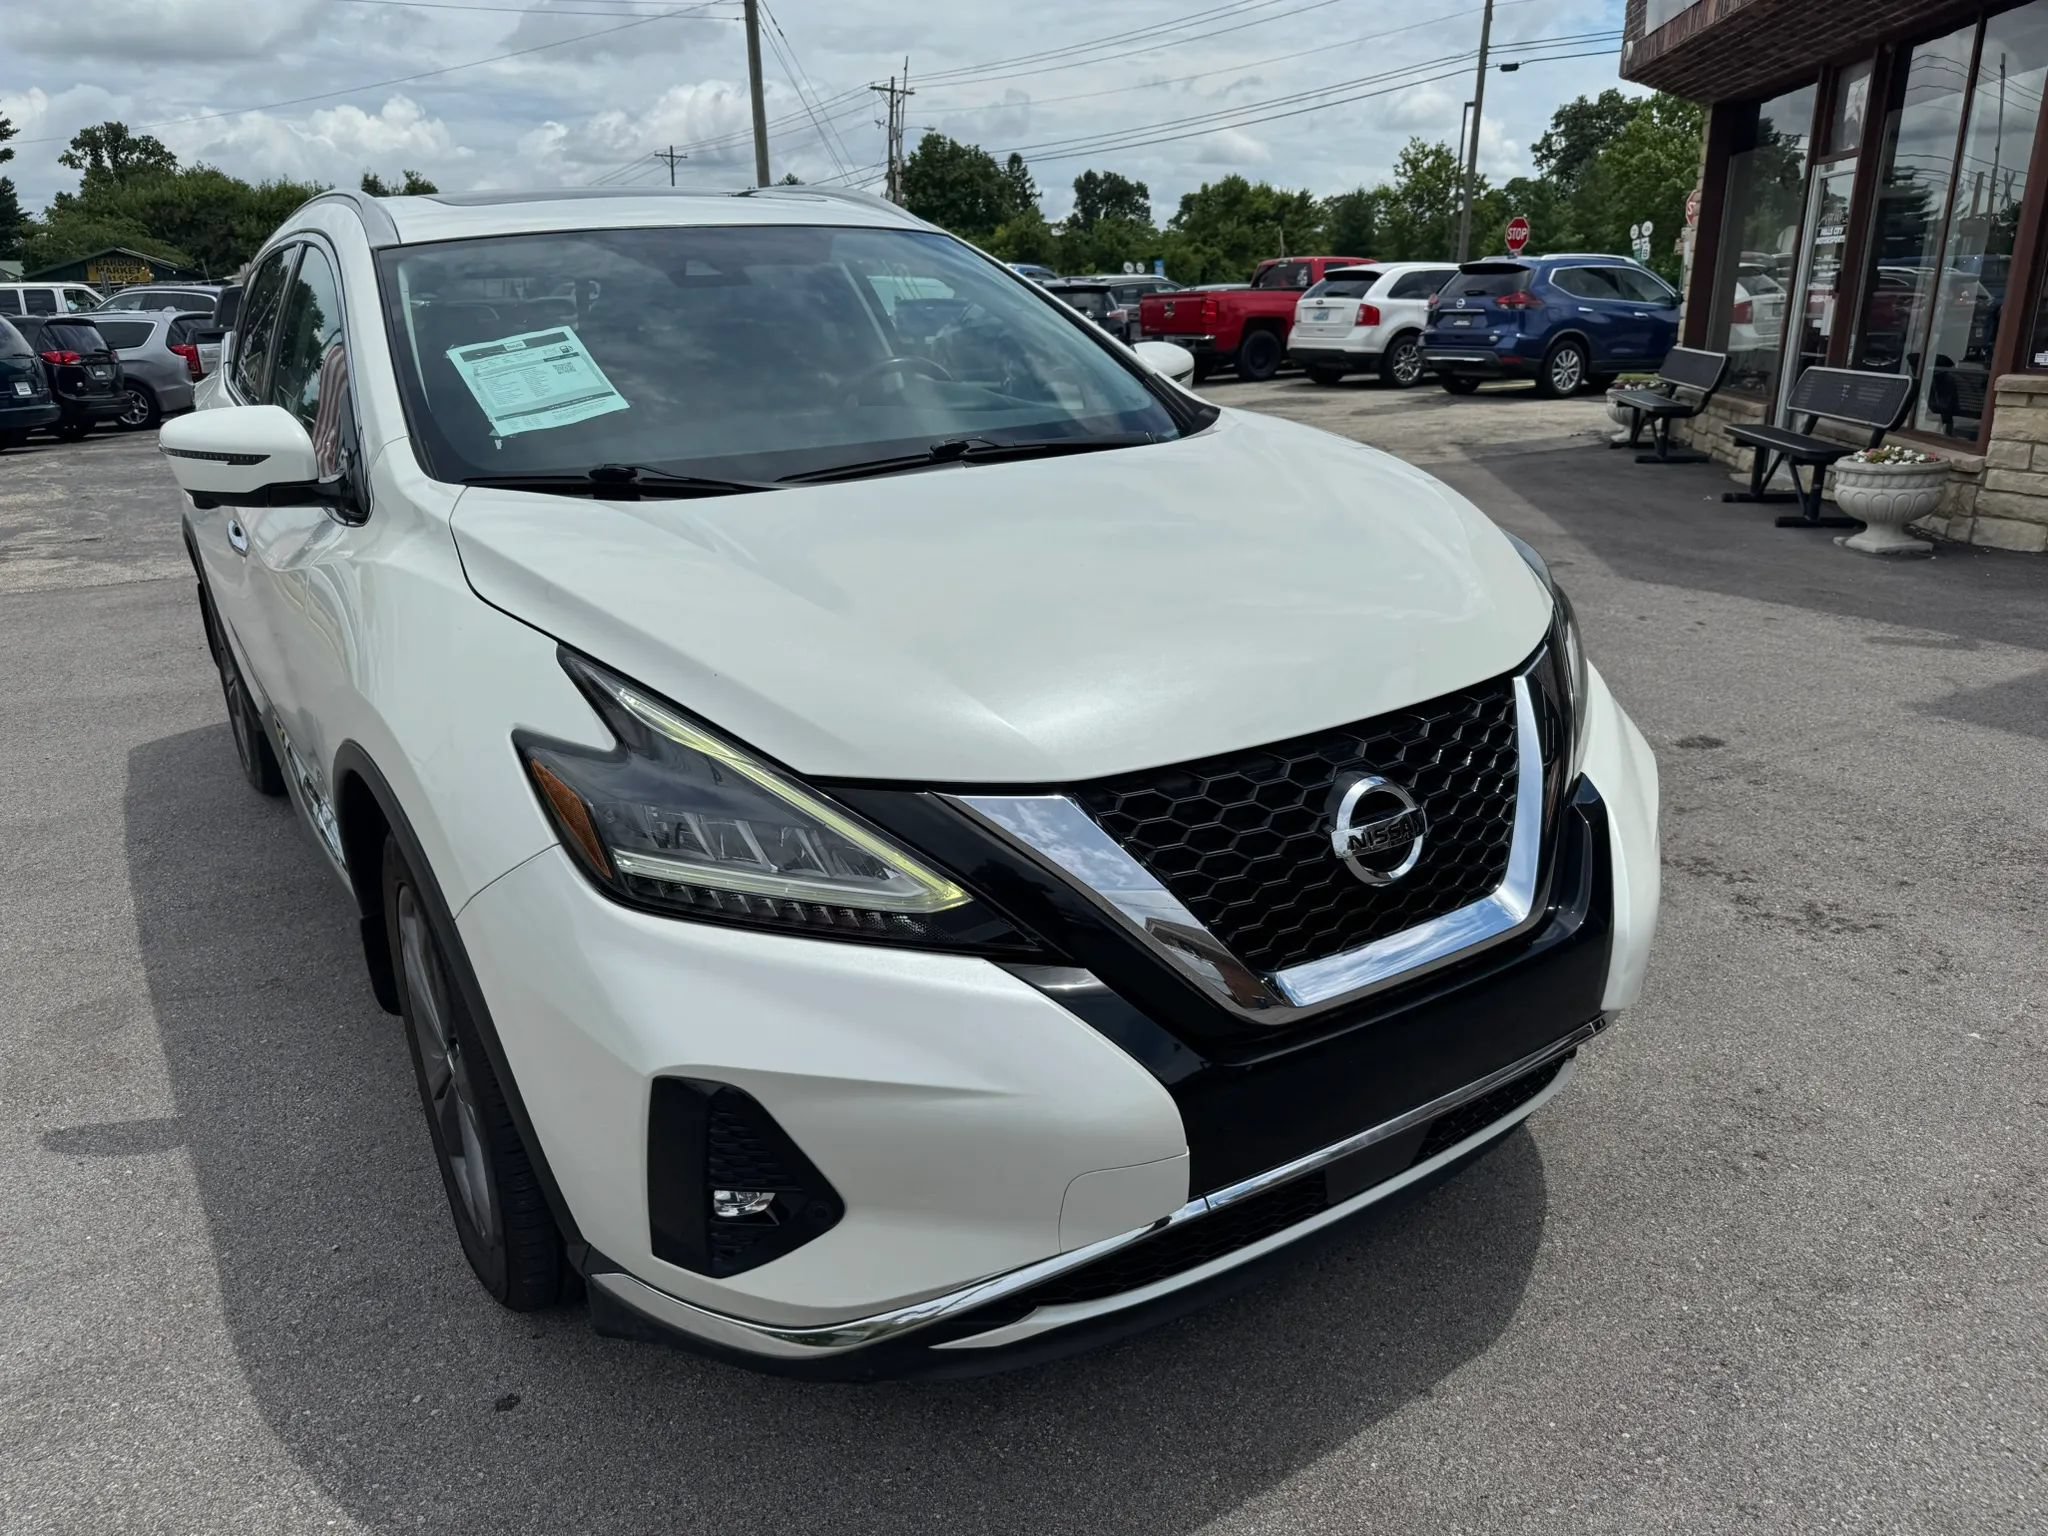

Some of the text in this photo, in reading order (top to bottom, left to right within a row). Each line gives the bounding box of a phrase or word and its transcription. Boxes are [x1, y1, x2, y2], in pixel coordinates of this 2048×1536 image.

[1507, 227, 1527, 240] STOP
[95, 266, 141, 274] MARKET
[1346, 813, 1422, 851] NISSAN
